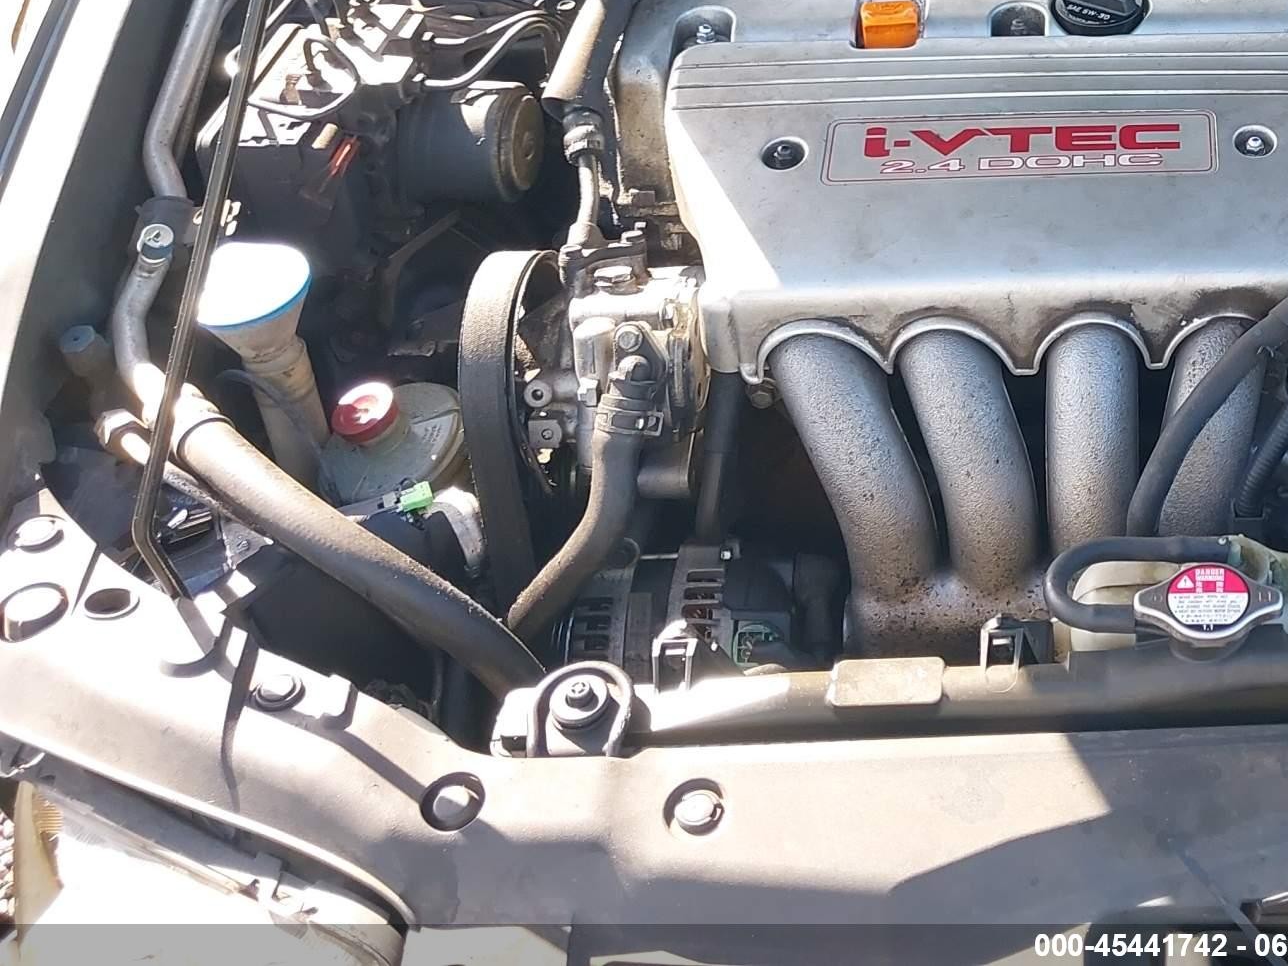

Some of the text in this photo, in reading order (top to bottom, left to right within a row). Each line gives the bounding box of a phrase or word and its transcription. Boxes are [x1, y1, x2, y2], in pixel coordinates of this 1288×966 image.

[1066, 4, 1082, 13] SAE
[1082, 8, 1111, 21] 5W-30
[863, 124, 1181, 158] i-VTEC
[879, 152, 1164, 174] 2.4 DOHC
